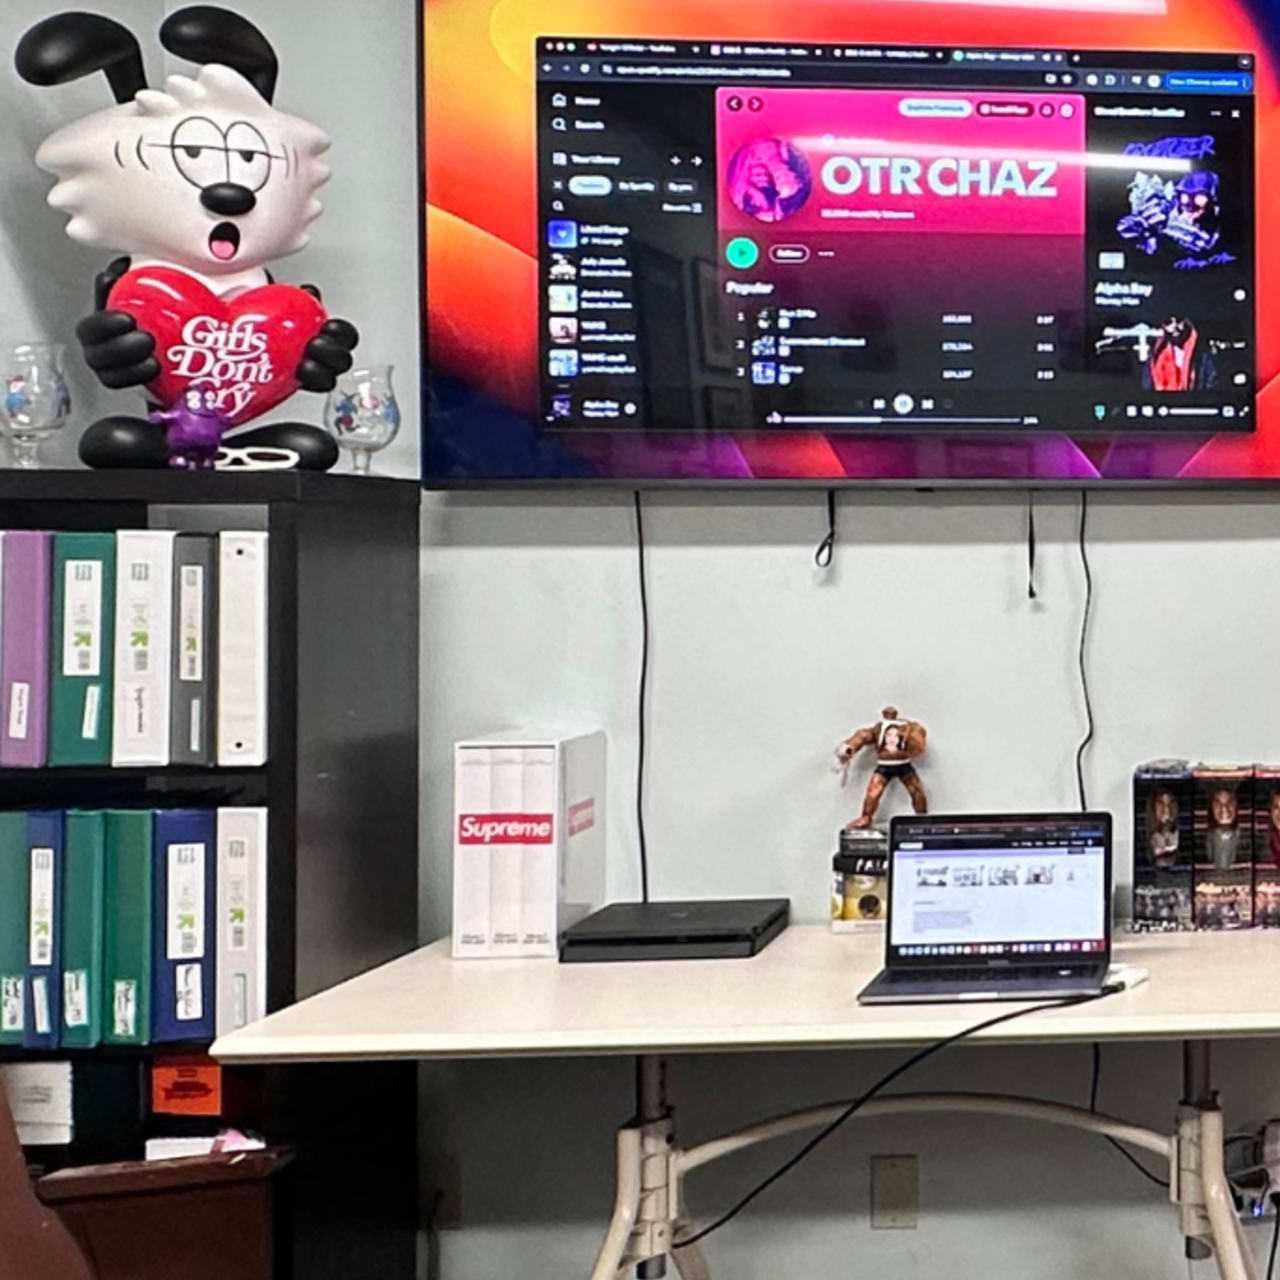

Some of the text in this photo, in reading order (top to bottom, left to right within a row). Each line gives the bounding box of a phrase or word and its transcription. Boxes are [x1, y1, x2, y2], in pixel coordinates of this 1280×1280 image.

[821, 155, 1058, 197] OTR CHAZ
[182, 314, 268, 361] Girls
[461, 817, 551, 842] Supreme
